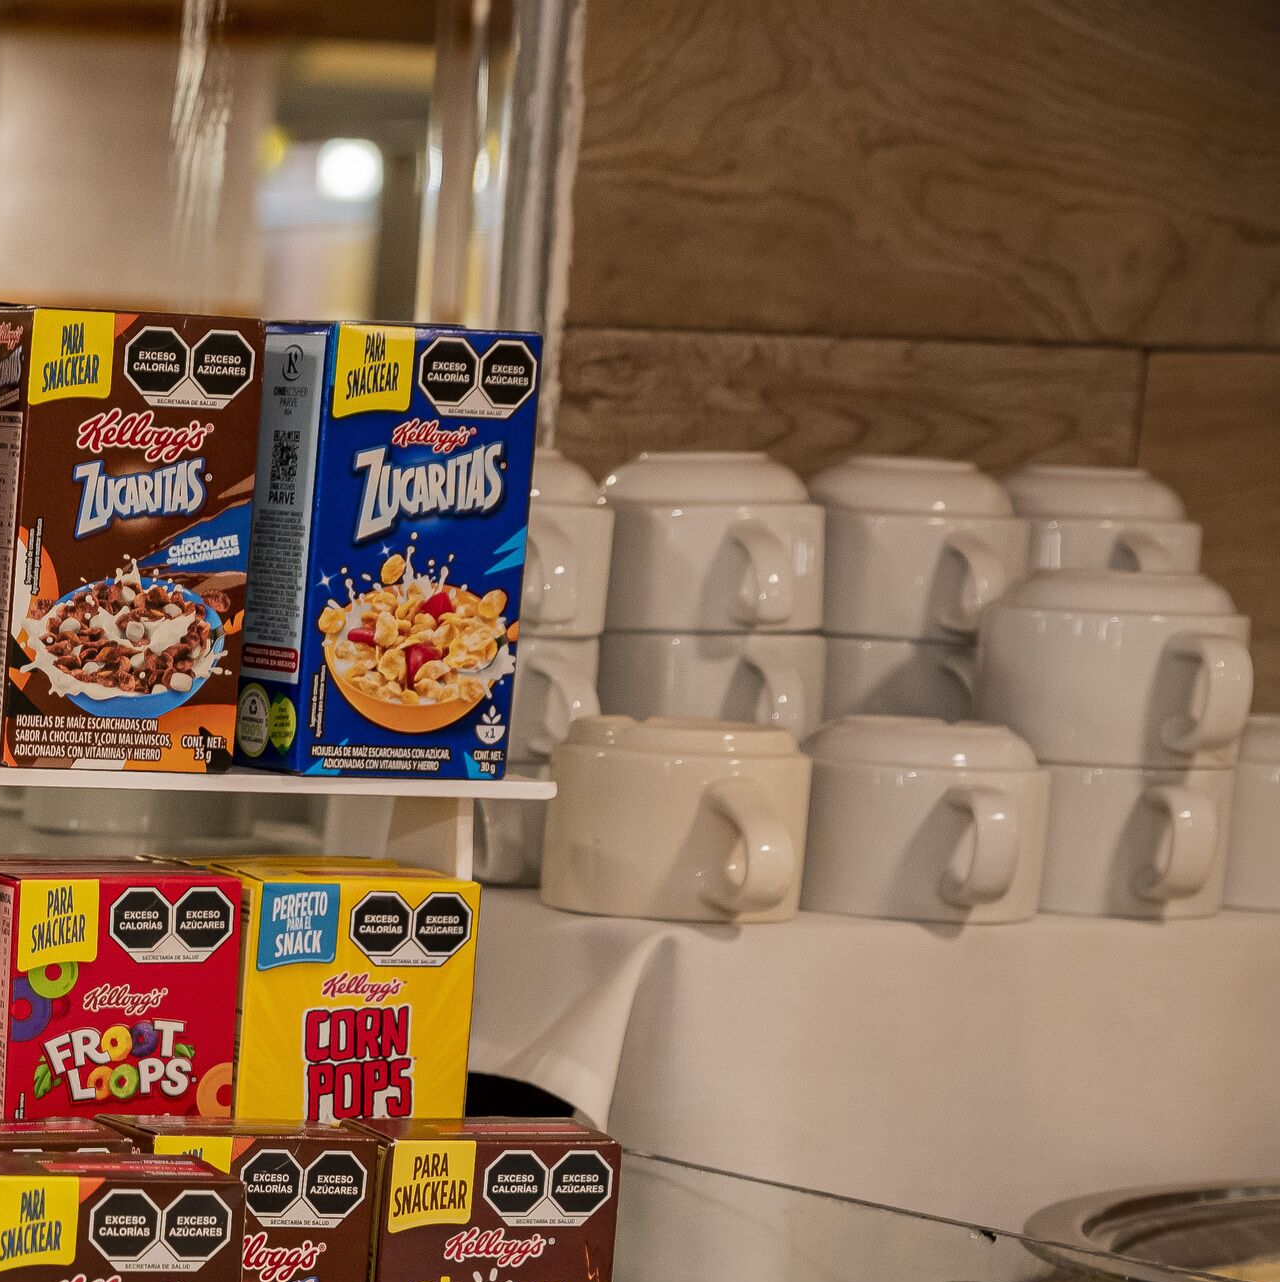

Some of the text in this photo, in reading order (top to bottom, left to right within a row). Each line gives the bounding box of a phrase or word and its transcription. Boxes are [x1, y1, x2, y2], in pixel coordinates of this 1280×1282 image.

[61, 322, 84, 356] PARA
[364, 332, 385, 364] PARA
[133, 362, 180, 373] CALORÍAS
[139, 351, 176, 361] EXCESO
[197, 365, 246, 376] AZÚCARES
[204, 355, 241, 364] EXCESO
[42, 354, 99, 393] SNACKEAR
[346, 361, 399, 400] SNACKEAR
[77, 407, 210, 461] Kellogg's
[392, 418, 470, 453] Kellogg's
[73, 458, 206, 539] ZUCARITAS
[353, 441, 503, 543] ZUCARITAS
[169, 535, 239, 557] CHOCOLATE
[47, 885, 73, 918] PARA
[124, 911, 159, 920] EXCESO
[186, 911, 220, 919] EXCESO
[272, 891, 328, 922] PERFECTO
[31, 914, 85, 953] SNACKEAR
[120, 921, 163, 930] CALORÍAS
[180, 921, 225, 930] AZÚCARES
[275, 930, 322, 958] SNACK
[83, 983, 162, 1016] Kellogg's
[322, 973, 402, 1002] Kellogg's
[44, 1018, 188, 1076] FROOT
[303, 1005, 410, 1063] CORN
[63, 1057, 192, 1106] LOOPS
[305, 1058, 413, 1122] POPS
[413, 1153, 448, 1180] PARA
[393, 1180, 467, 1218] SNACKEAR
[492, 1184, 537, 1193] CALORÍAS
[556, 1184, 604, 1193] AZÚCARES
[20, 1187, 45, 1223] PARA
[105, 1216, 146, 1225] EXCESO
[177, 1216, 217, 1225] EXCESO
[0, 1221, 62, 1261] SNACKEAR
[99, 1226, 150, 1237] CALORÍAS
[169, 1226, 222, 1237] AZÚCARES
[444, 1227, 545, 1268] Kellogg's
